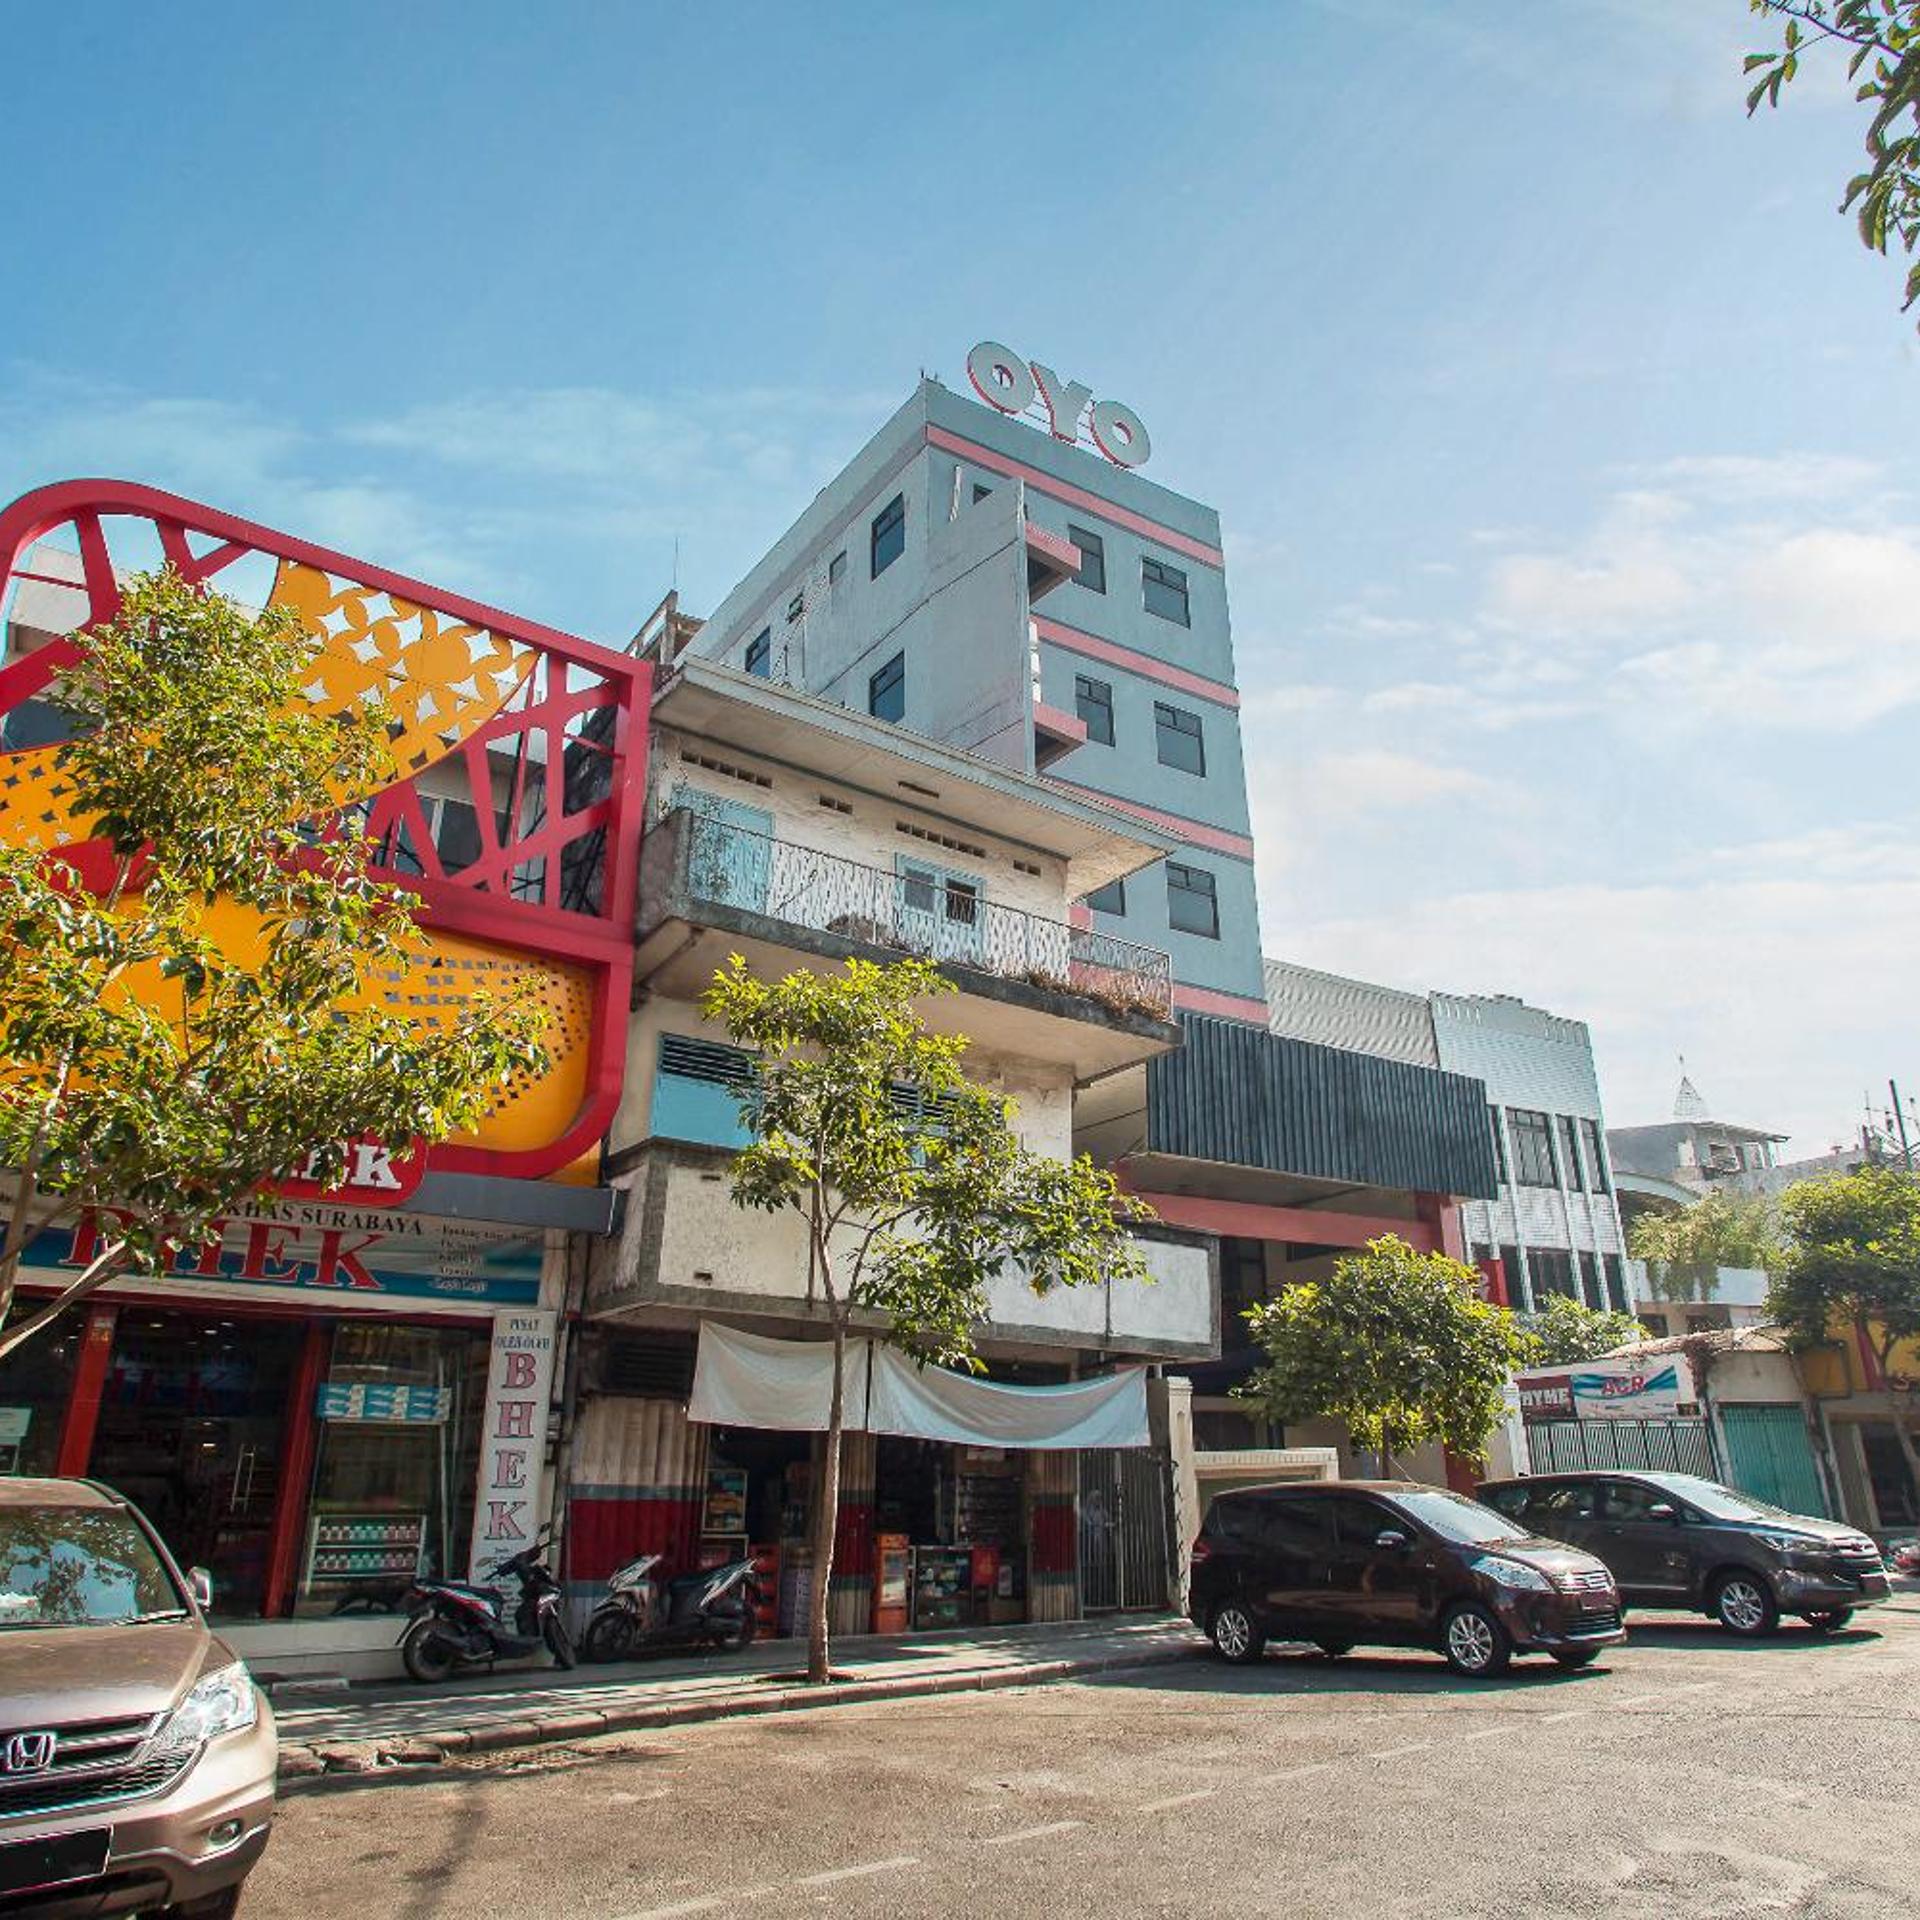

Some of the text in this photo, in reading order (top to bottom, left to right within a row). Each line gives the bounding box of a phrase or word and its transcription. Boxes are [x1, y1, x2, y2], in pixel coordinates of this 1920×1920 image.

[966, 341, 1151, 468] OYO
[301, 1207, 422, 1236] SURABAYA
[483, 1351, 537, 1541] BHEK
